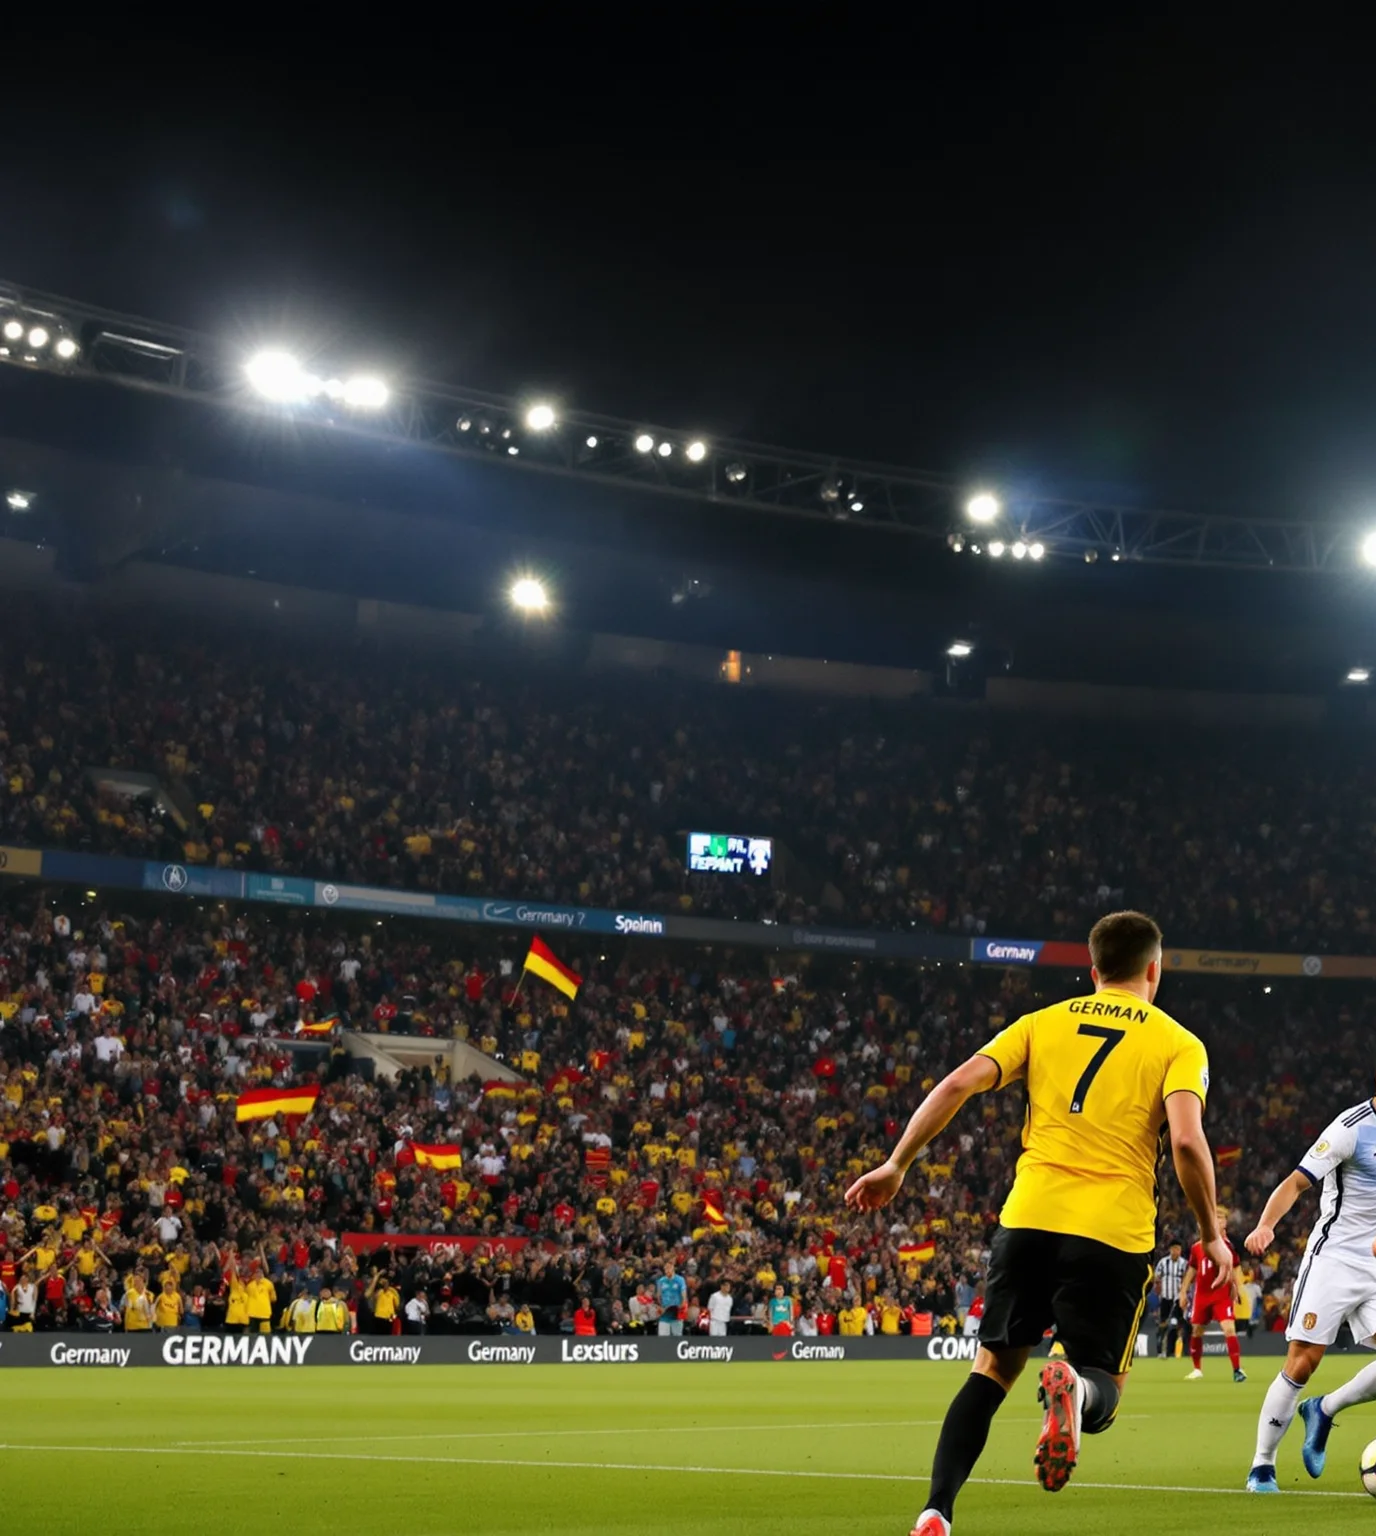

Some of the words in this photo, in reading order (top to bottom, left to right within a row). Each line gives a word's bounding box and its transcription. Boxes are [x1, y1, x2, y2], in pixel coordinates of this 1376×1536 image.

[1069, 1000, 1149, 1024] GERMAN
[1069, 1023, 1126, 1114] 7
[50, 1342, 131, 1367] Germany
[162, 1335, 313, 1365] GERMANY
[350, 1340, 421, 1364] Germany
[468, 1340, 536, 1364] Germany
[677, 1340, 733, 1362] Germany
[927, 1336, 980, 1360] COM
